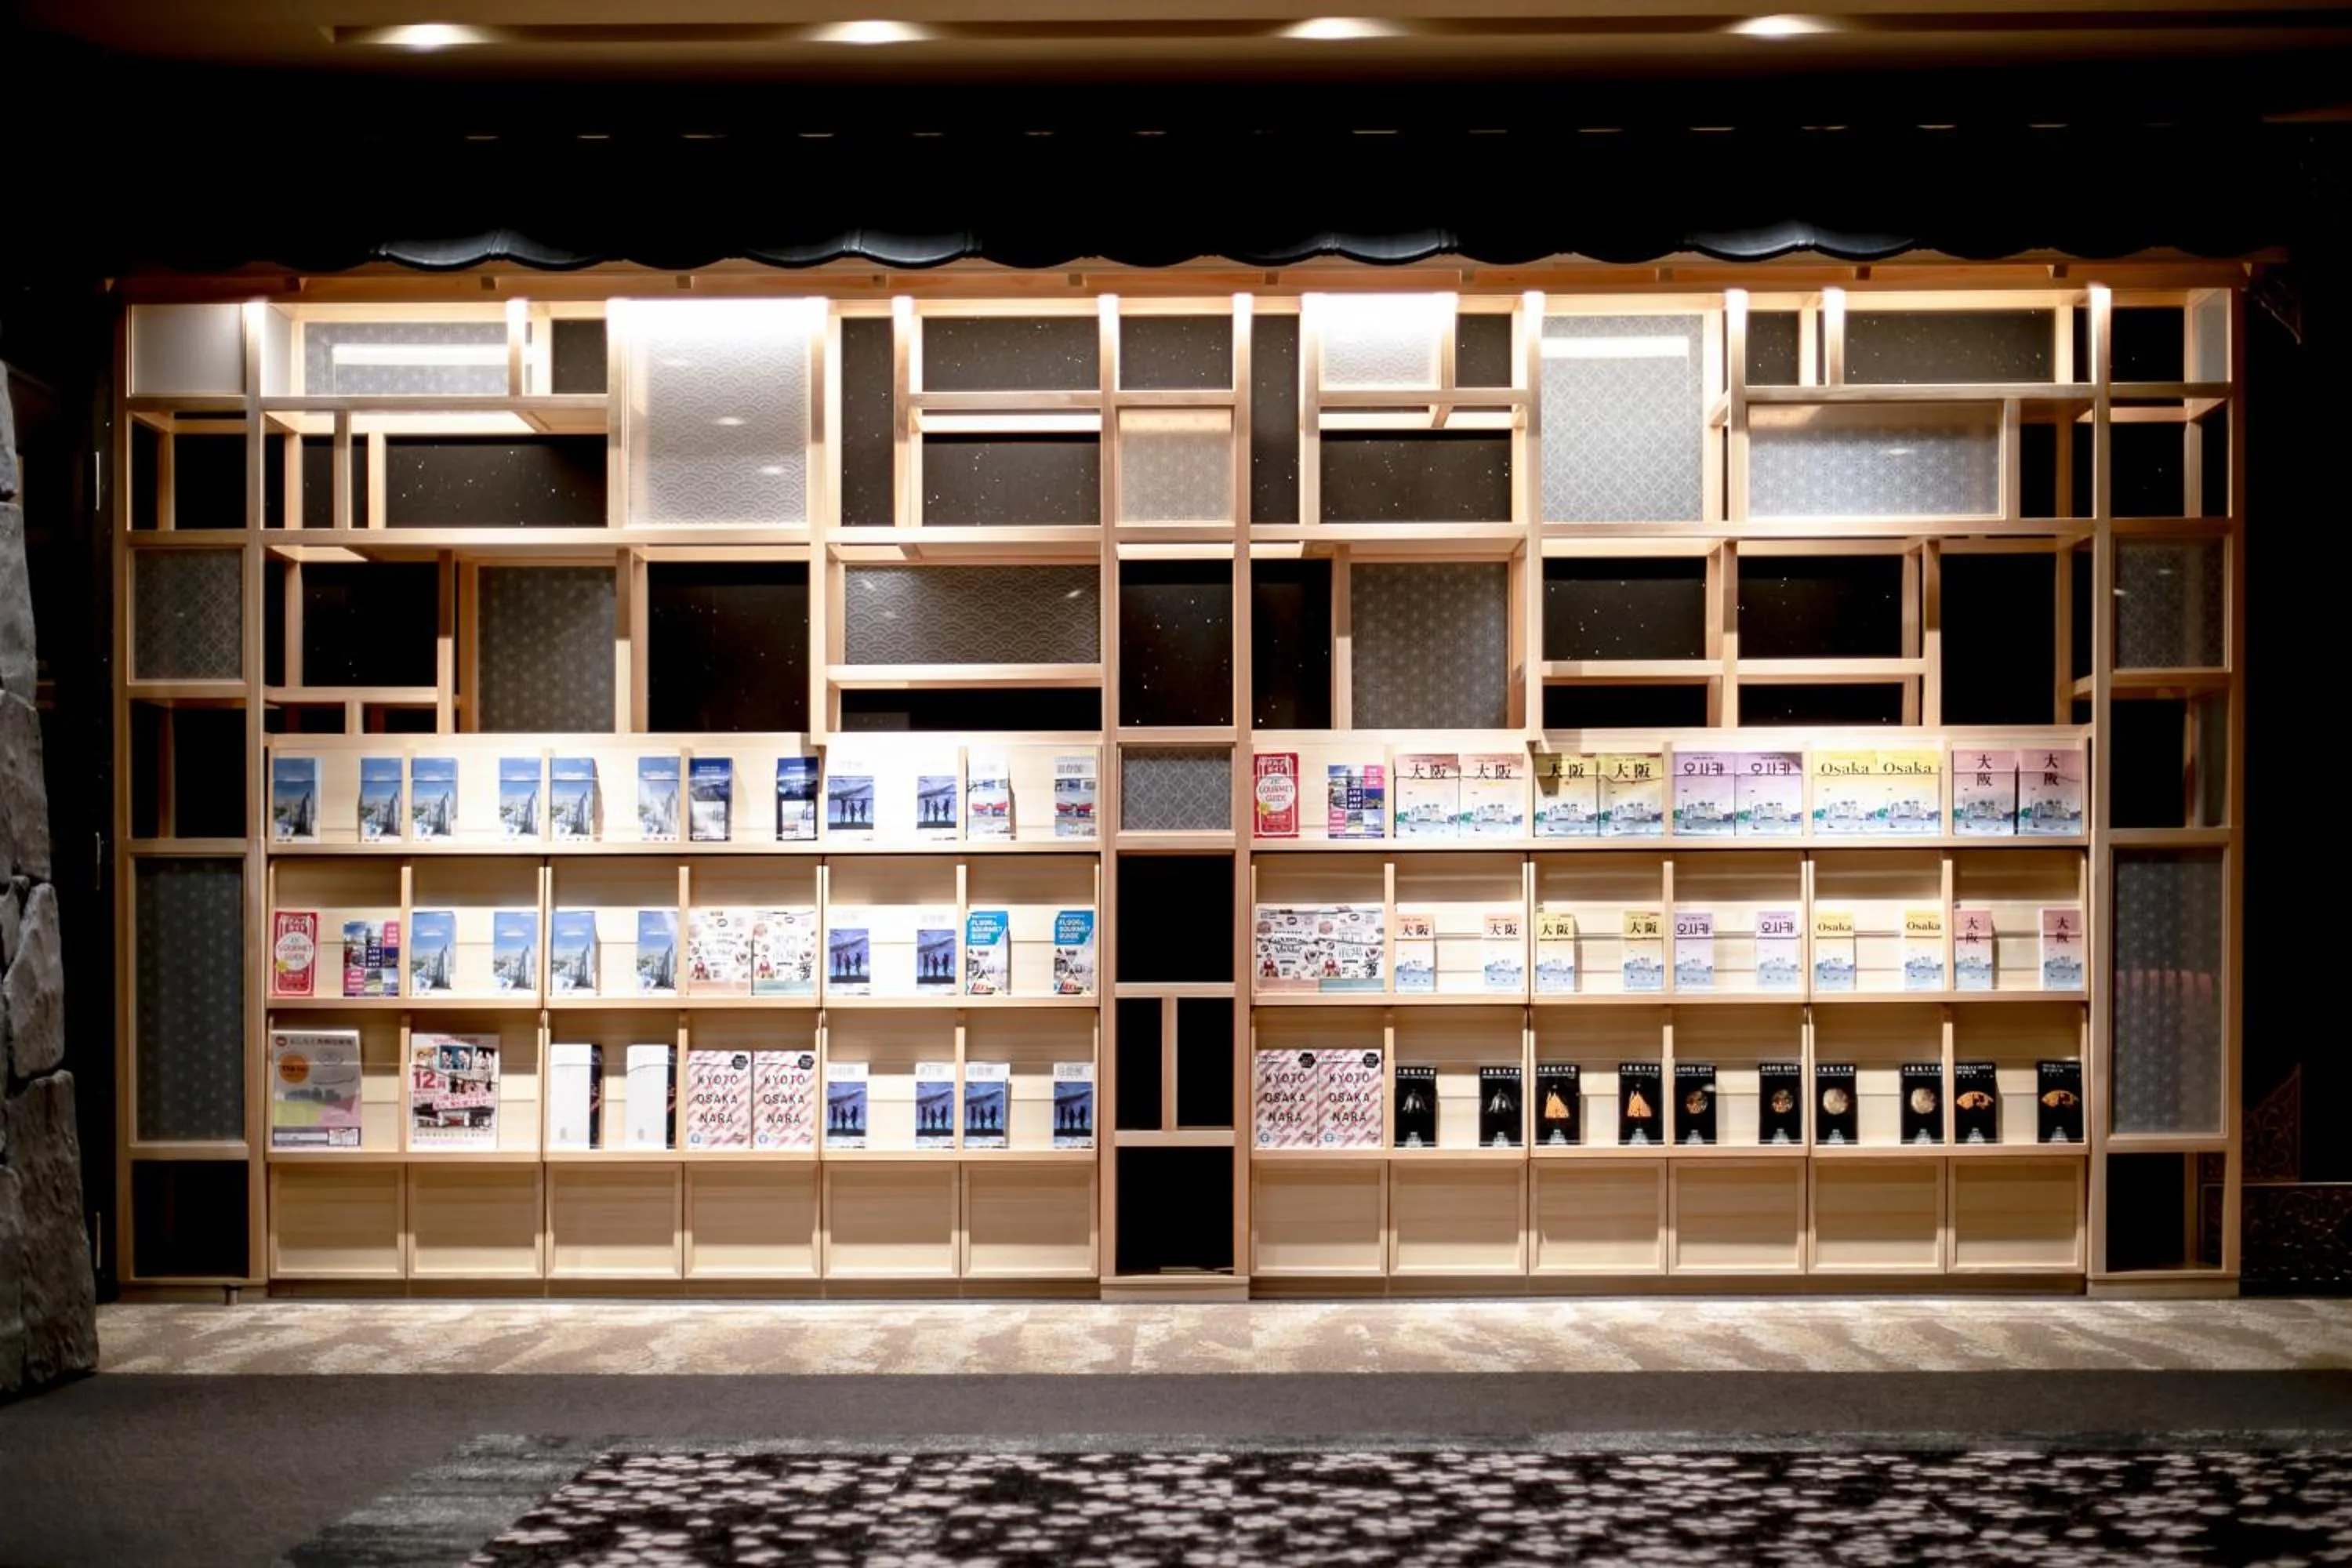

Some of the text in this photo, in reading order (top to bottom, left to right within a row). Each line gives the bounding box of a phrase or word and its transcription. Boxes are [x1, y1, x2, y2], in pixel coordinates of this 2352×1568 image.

[1410, 764, 1446, 779] 大阪
[1475, 764, 1511, 779] 大阪
[1550, 763, 1584, 779] 大阪
[1616, 763, 1650, 779] 大阪
[1820, 761, 1869, 775] Osaka
[1883, 761, 1932, 775] Osaka
[1403, 924, 1430, 936] 大阪
[1490, 924, 1518, 936] 大阪
[1542, 924, 1569, 936] 大阪
[1631, 922, 1657, 935] 大阪
[1677, 923, 1709, 935] 오사카
[1761, 921, 1795, 934] 오사카
[1817, 922, 1853, 932] Osaka
[1906, 921, 1941, 931] Osaka
[697, 1074, 739, 1085] KYOTO
[764, 1075, 806, 1086] KYOTO
[1265, 1072, 1307, 1083] KYOTO
[1329, 1072, 1370, 1083] KYOTO
[696, 1094, 738, 1105] OSAKA
[763, 1094, 805, 1105] OSAKA
[1265, 1092, 1305, 1103] OSAKA
[1328, 1092, 1370, 1103] OSAKA
[699, 1113, 734, 1123] NARA
[766, 1113, 801, 1123] NARA
[1268, 1112, 1303, 1122] NARA
[1332, 1112, 1367, 1122] NARA
